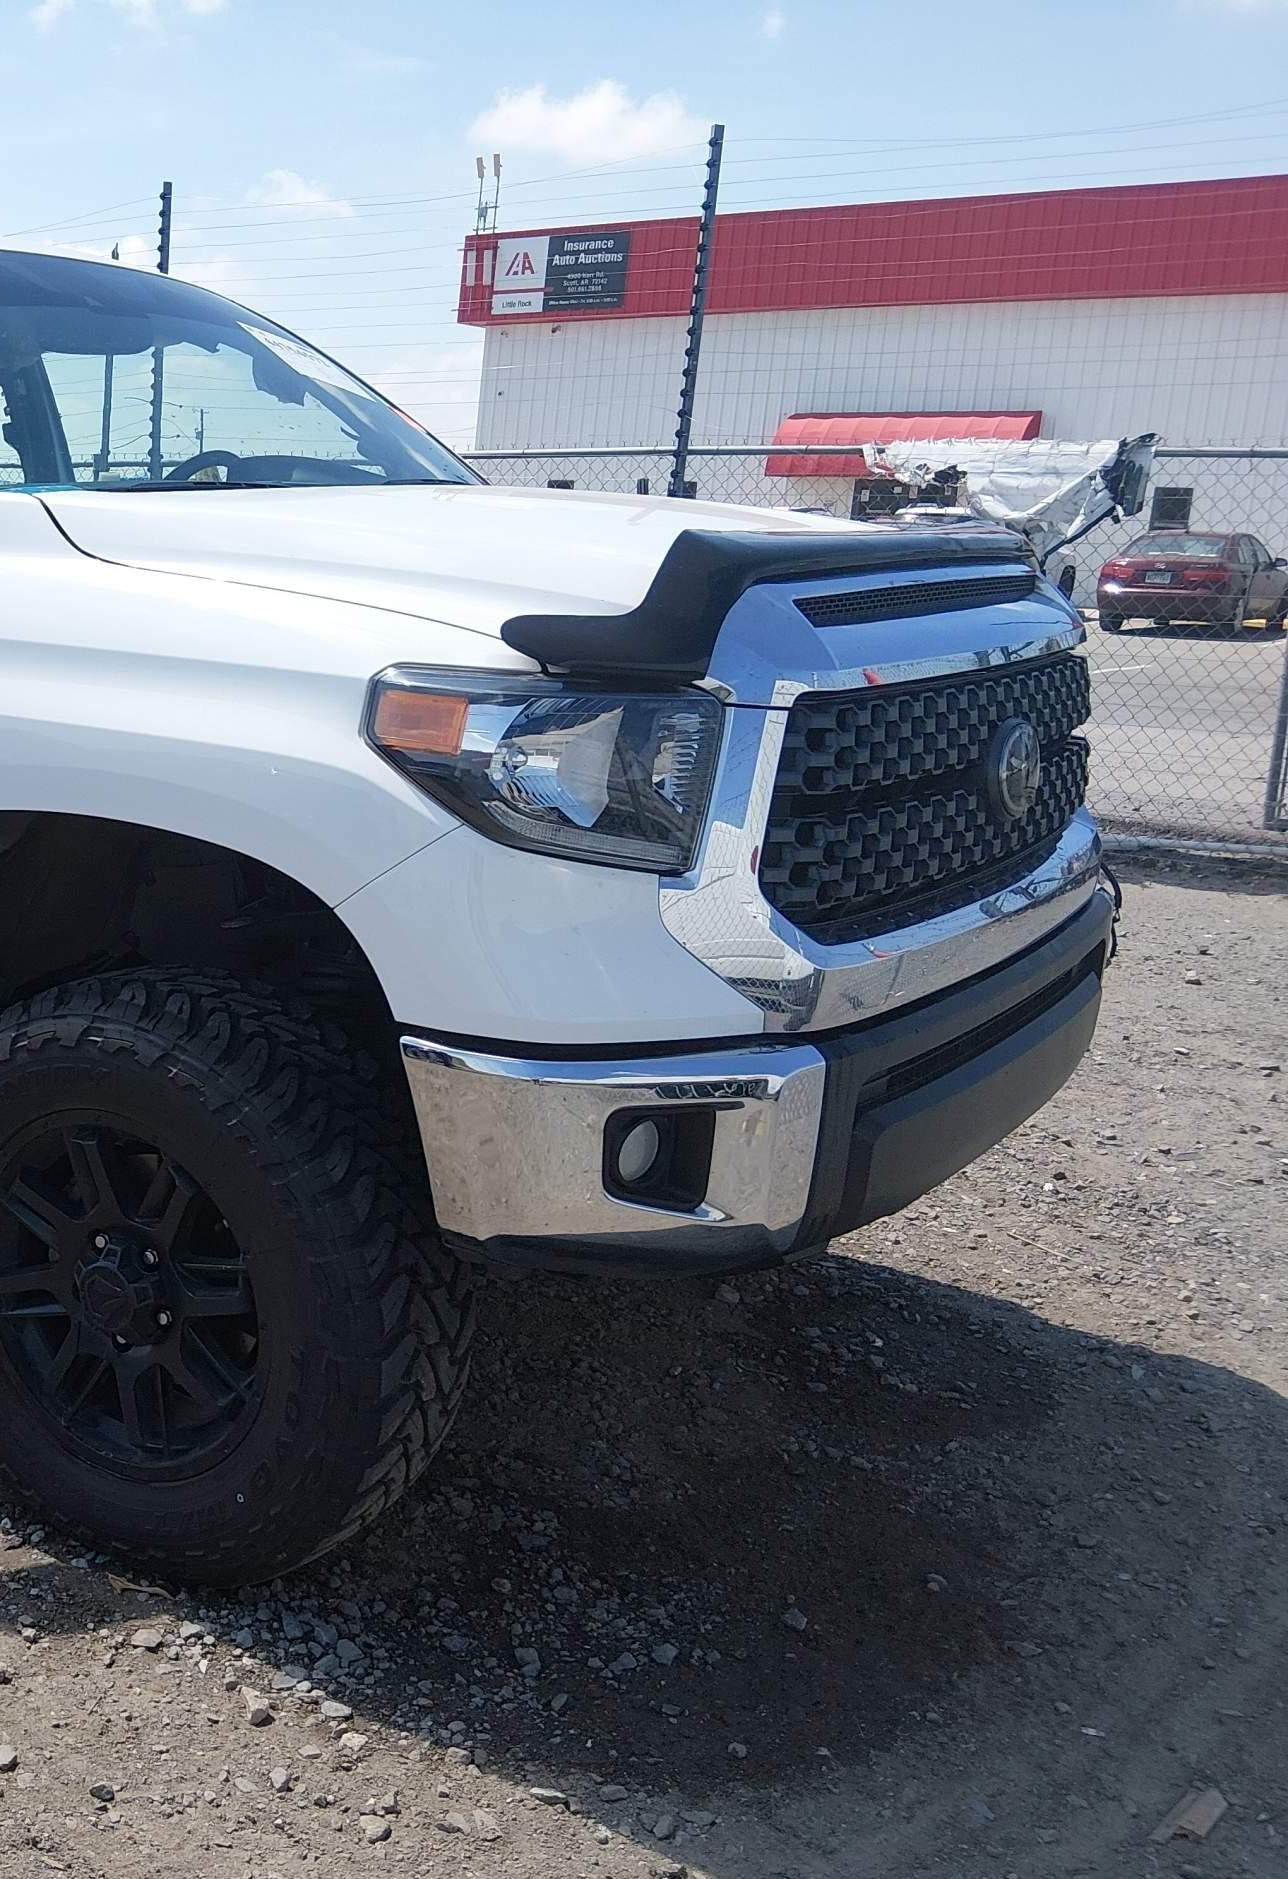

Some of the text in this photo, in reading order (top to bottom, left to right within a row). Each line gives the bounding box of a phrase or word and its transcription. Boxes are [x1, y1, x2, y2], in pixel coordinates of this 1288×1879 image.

[563, 238, 614, 252] Insurance
[552, 251, 624, 267] Auto Auctions
